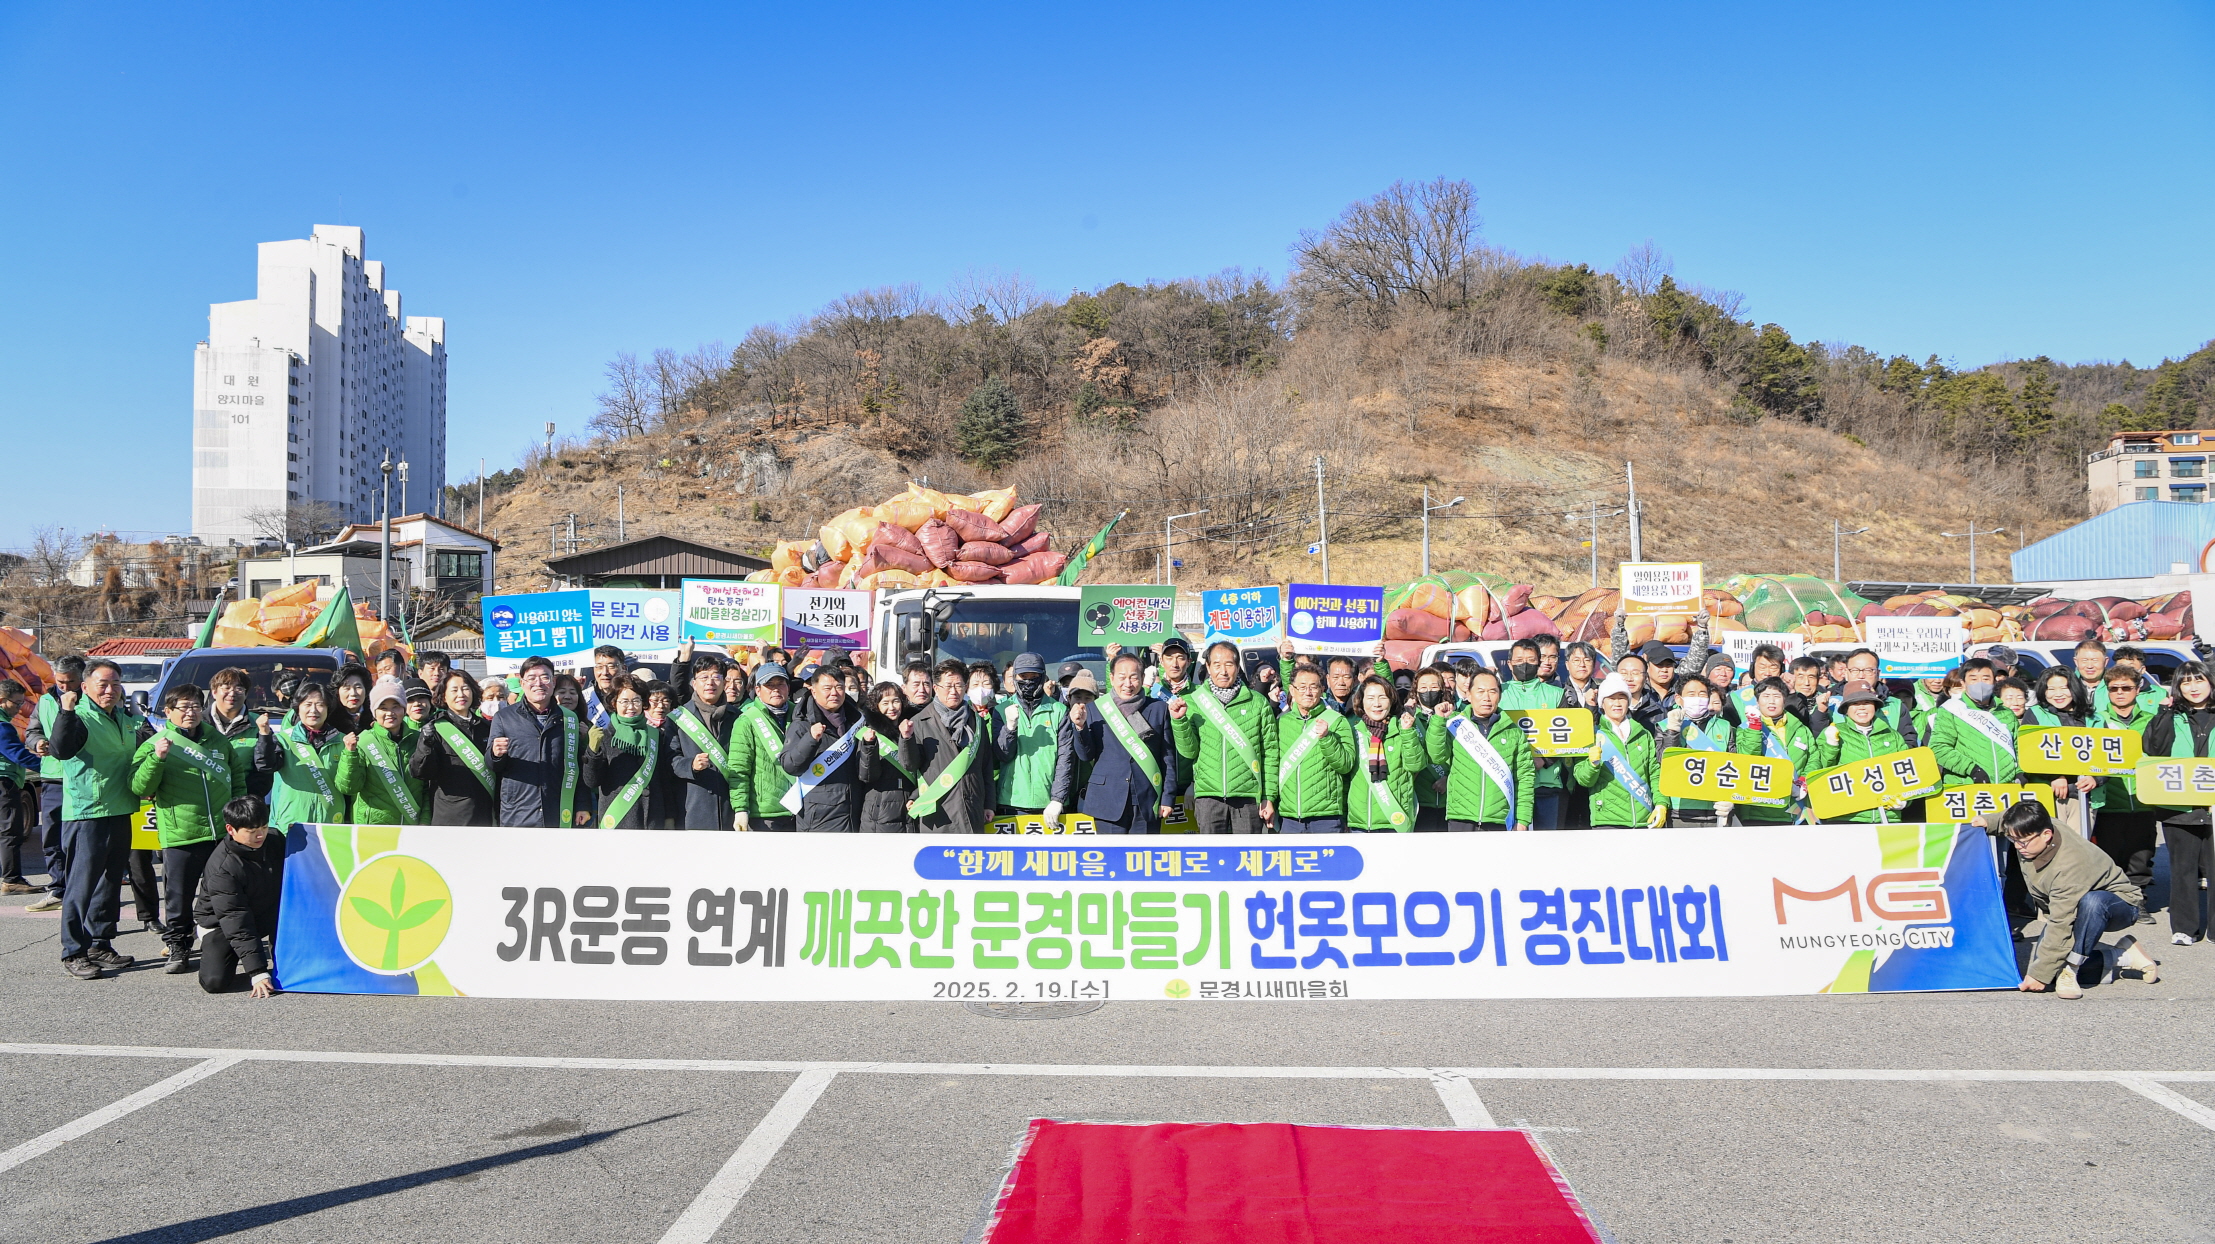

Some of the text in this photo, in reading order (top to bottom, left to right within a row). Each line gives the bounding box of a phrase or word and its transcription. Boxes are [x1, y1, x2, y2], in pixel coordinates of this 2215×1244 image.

[217, 394, 265, 406] 양지마을
[231, 414, 250, 425] 101
[1633, 570, 1689, 583] 일회용품 NO!
[1220, 590, 1262, 606] 4층 이하
[1670, 584, 1692, 596] YES!
[591, 601, 640, 618] 문 닫고
[809, 596, 847, 611] 전기와
[1112, 597, 1172, 610] 에어컨 대신
[1294, 596, 1379, 614] 에어컨과 선풍기
[517, 609, 560, 625] 사용하지
[561, 608, 583, 623] 않는
[689, 606, 771, 622] 새마을환경살리기
[795, 612, 859, 629] 가스 줄이기
[1124, 609, 1159, 621] 선풍기
[1208, 605, 1277, 631] 계단 이용하기
[1315, 615, 1378, 630] 함께 사용하기
[592, 623, 670, 642] 에어컨 사용
[1117, 621, 1163, 633] 사용하기
[498, 625, 584, 652] 플러그 뽑기
[2039, 733, 2124, 764] 산양면
[1684, 757, 1772, 793] 영순면
[1829, 758, 1919, 797] 마성면
[1772, 871, 1947, 925] MG
[497, 884, 1730, 971] 3R운동 연계 깨끗한 문경만들기 헌옷모으기 경진대회
[1780, 930, 1951, 950] MUNGYEONG CITY
[932, 981, 998, 999] 2025.
[1004, 981, 1026, 999] 2.
[1199, 980, 1350, 999] 문경시새마을회
